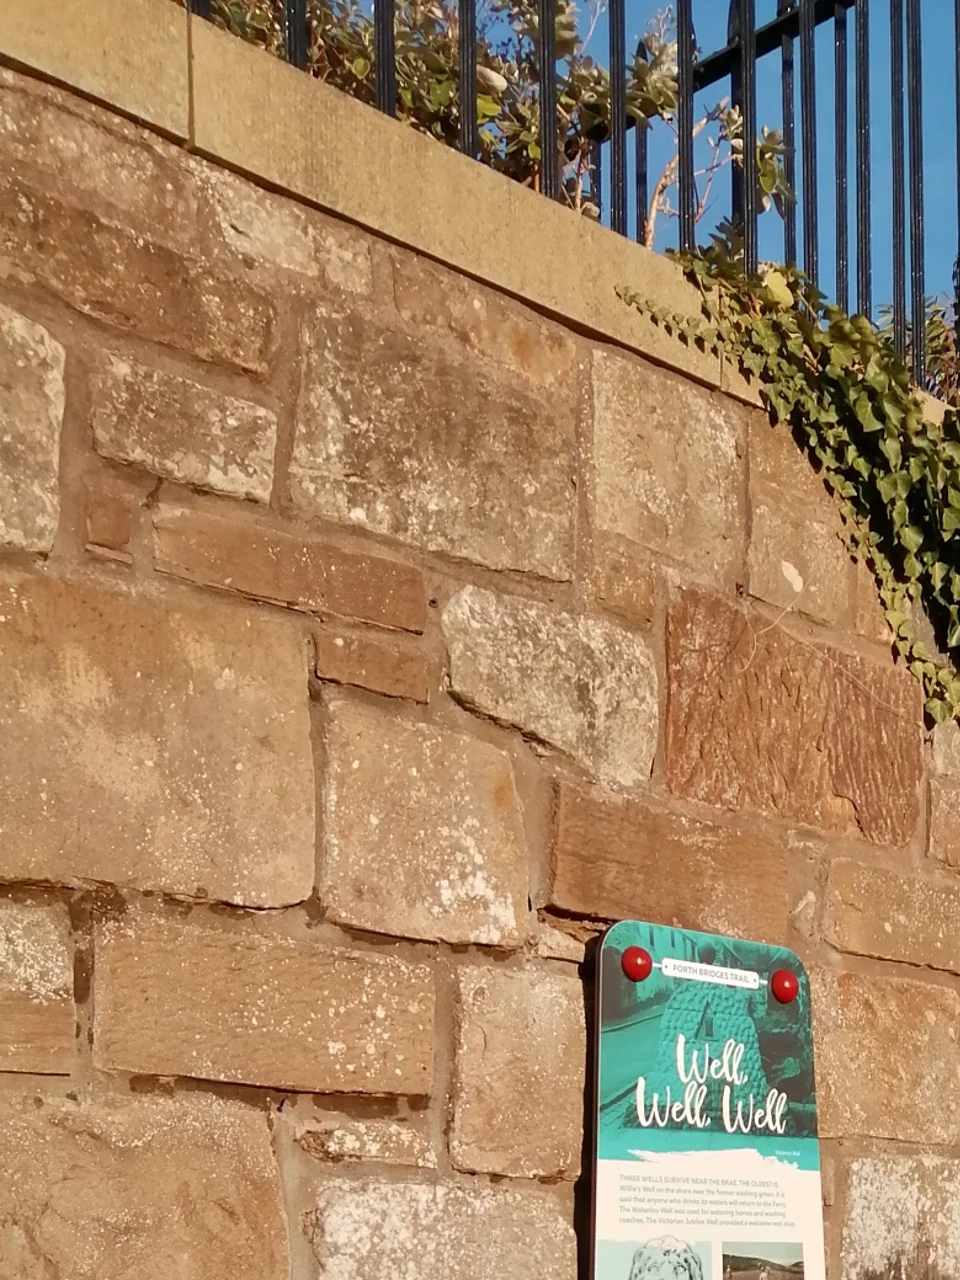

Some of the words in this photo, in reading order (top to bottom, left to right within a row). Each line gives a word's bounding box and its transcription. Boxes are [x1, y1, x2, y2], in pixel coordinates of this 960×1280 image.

[673, 964, 697, 975] FORTH
[699, 968, 729, 980] BRIDGES
[730, 972, 749, 983] TRAIL
[676, 1033, 748, 1085] Well,
[636, 1076, 711, 1128] Well,
[722, 1084, 787, 1134] Well
